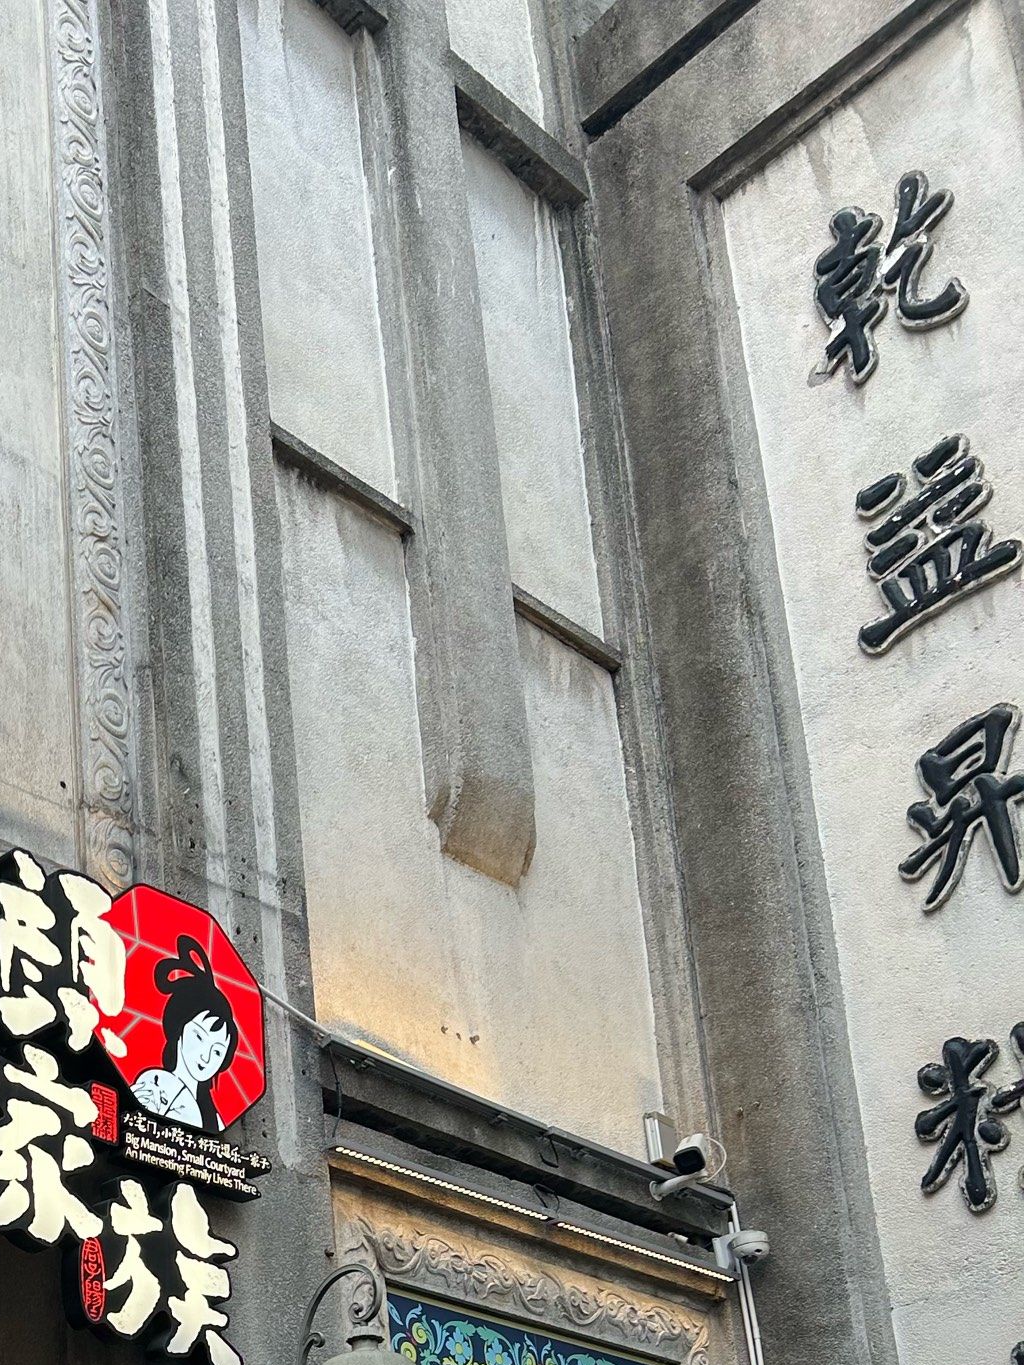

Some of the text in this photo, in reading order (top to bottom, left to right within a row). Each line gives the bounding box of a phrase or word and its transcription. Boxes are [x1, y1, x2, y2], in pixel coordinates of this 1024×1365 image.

[125, 1131, 140, 1149] Big
[181, 1149, 204, 1166] Small
[204, 1156, 246, 1179] Courtyard
[125, 1146, 138, 1160] An
[138, 1149, 185, 1177] Interesting
[185, 1163, 212, 1184] Family
[212, 1172, 233, 1188] Lives
